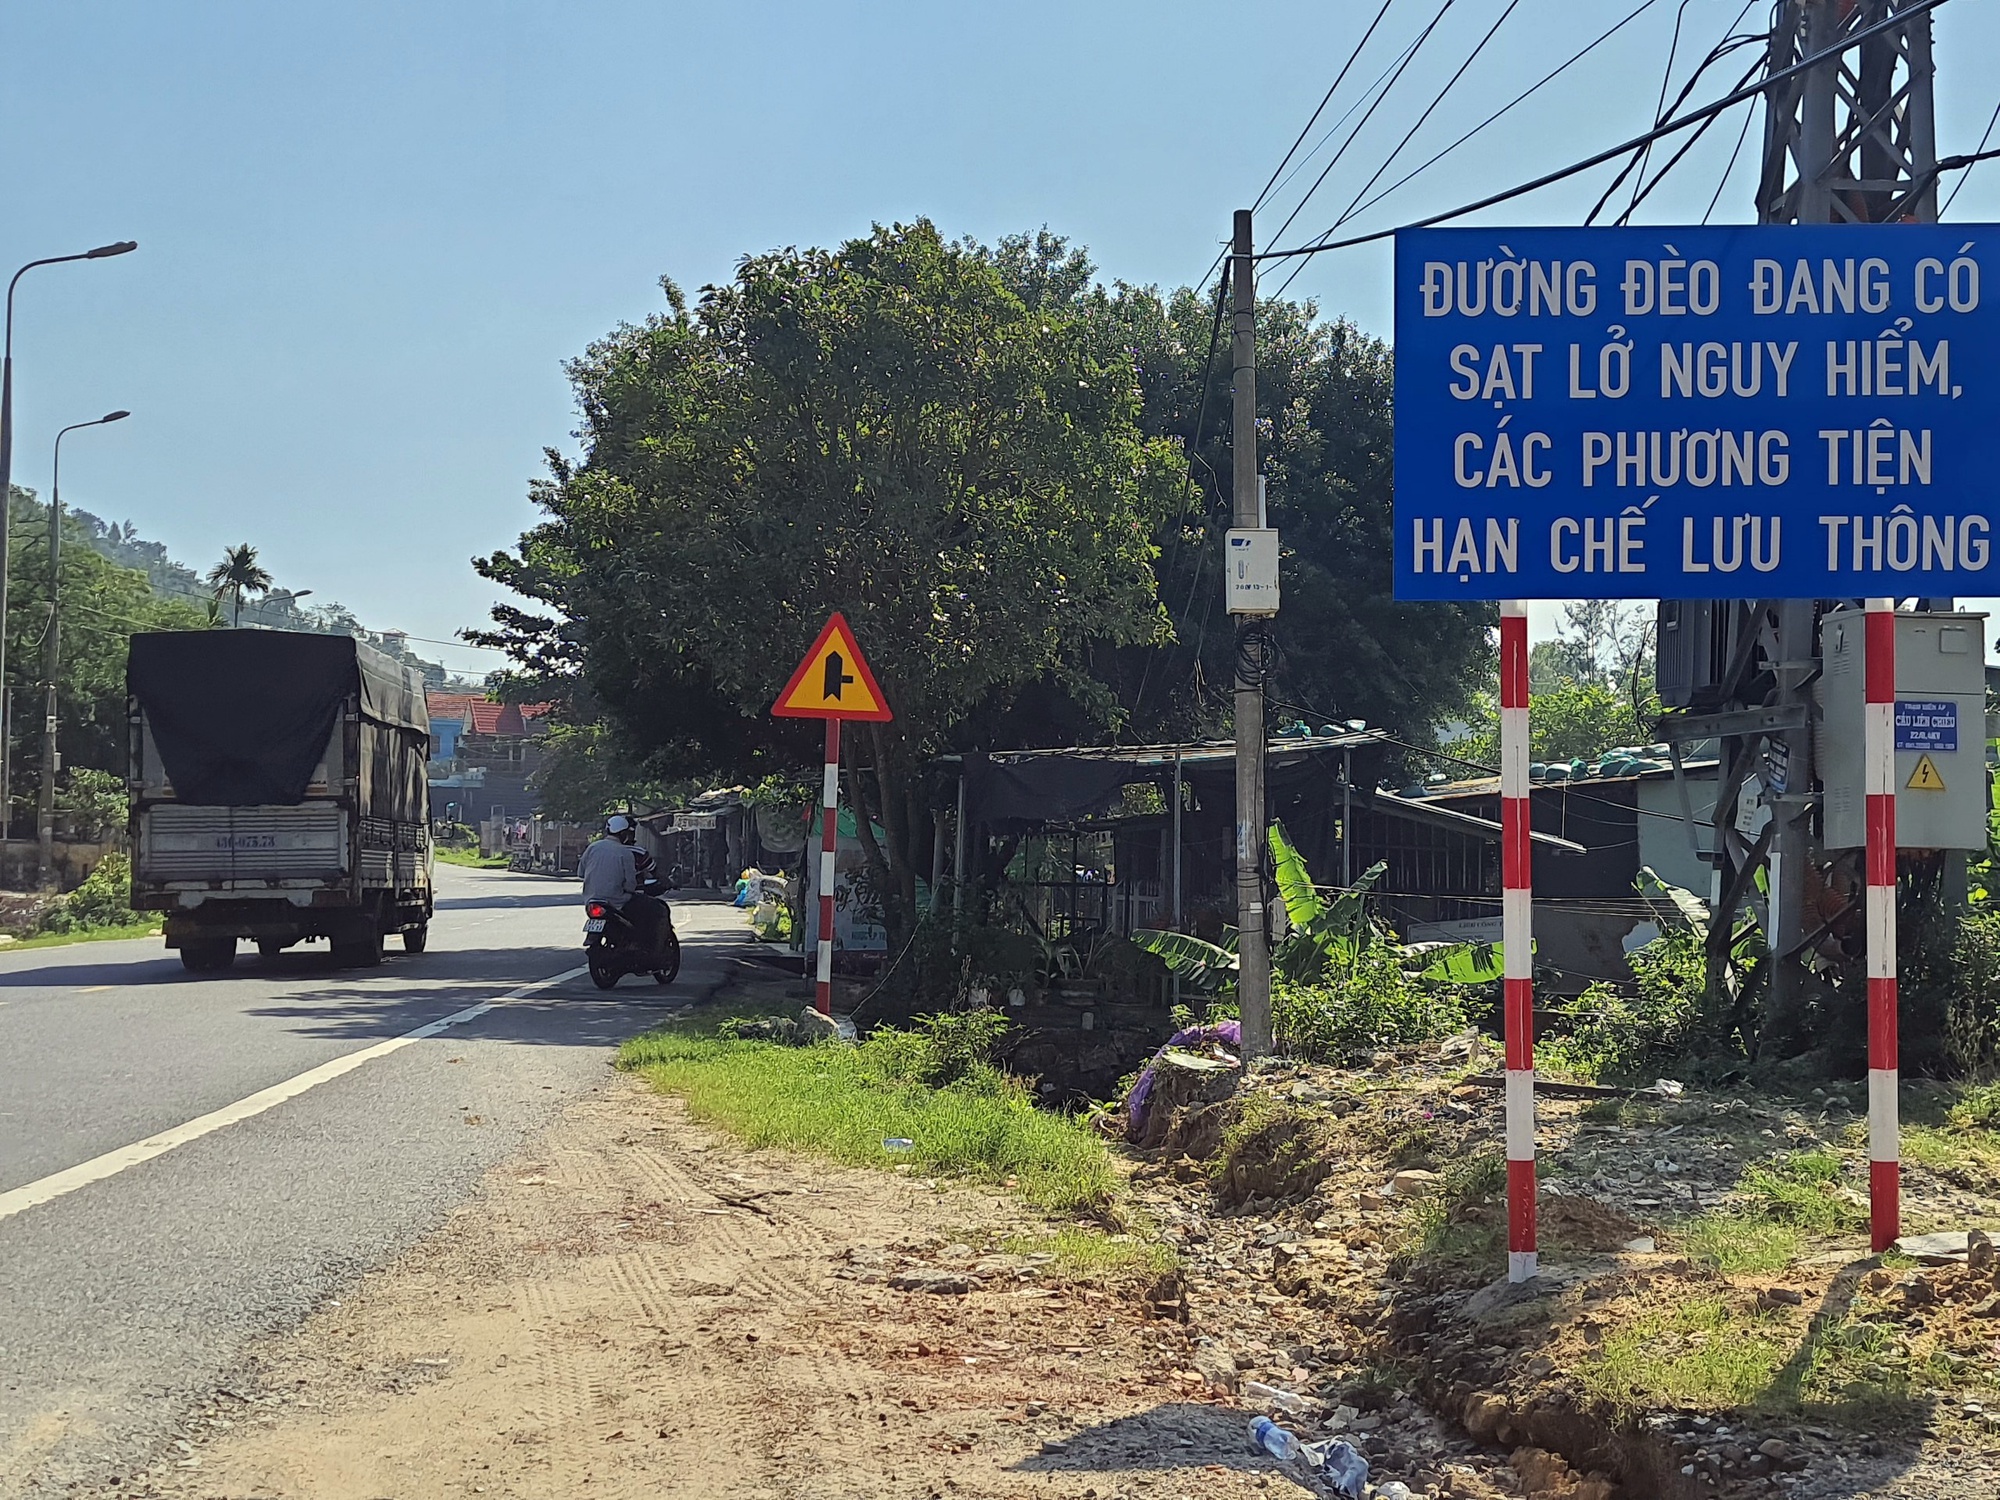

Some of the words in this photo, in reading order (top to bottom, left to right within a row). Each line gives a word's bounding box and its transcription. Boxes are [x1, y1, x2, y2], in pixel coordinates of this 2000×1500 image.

[1419, 244, 1597, 317] ĐƯỜNG
[1620, 243, 1720, 316] ĐÈO
[1748, 258, 1891, 314] ĐANG
[1915, 242, 1980, 314] CÓ
[1449, 343, 1543, 409] SẠT
[1569, 324, 1634, 399] LỞ
[1661, 341, 1798, 398] NGUY
[1826, 317, 1962, 399] HIỂM,
[1454, 415, 1552, 488] CÁC
[1582, 428, 1789, 487] PHƯƠNG
[1818, 418, 1931, 495] TIỆN
[1413, 517, 1518, 583] HẠN
[1550, 495, 1660, 573] CHẾ
[1682, 513, 1781, 572] LƯU
[1818, 504, 1990, 571] THÔNG
